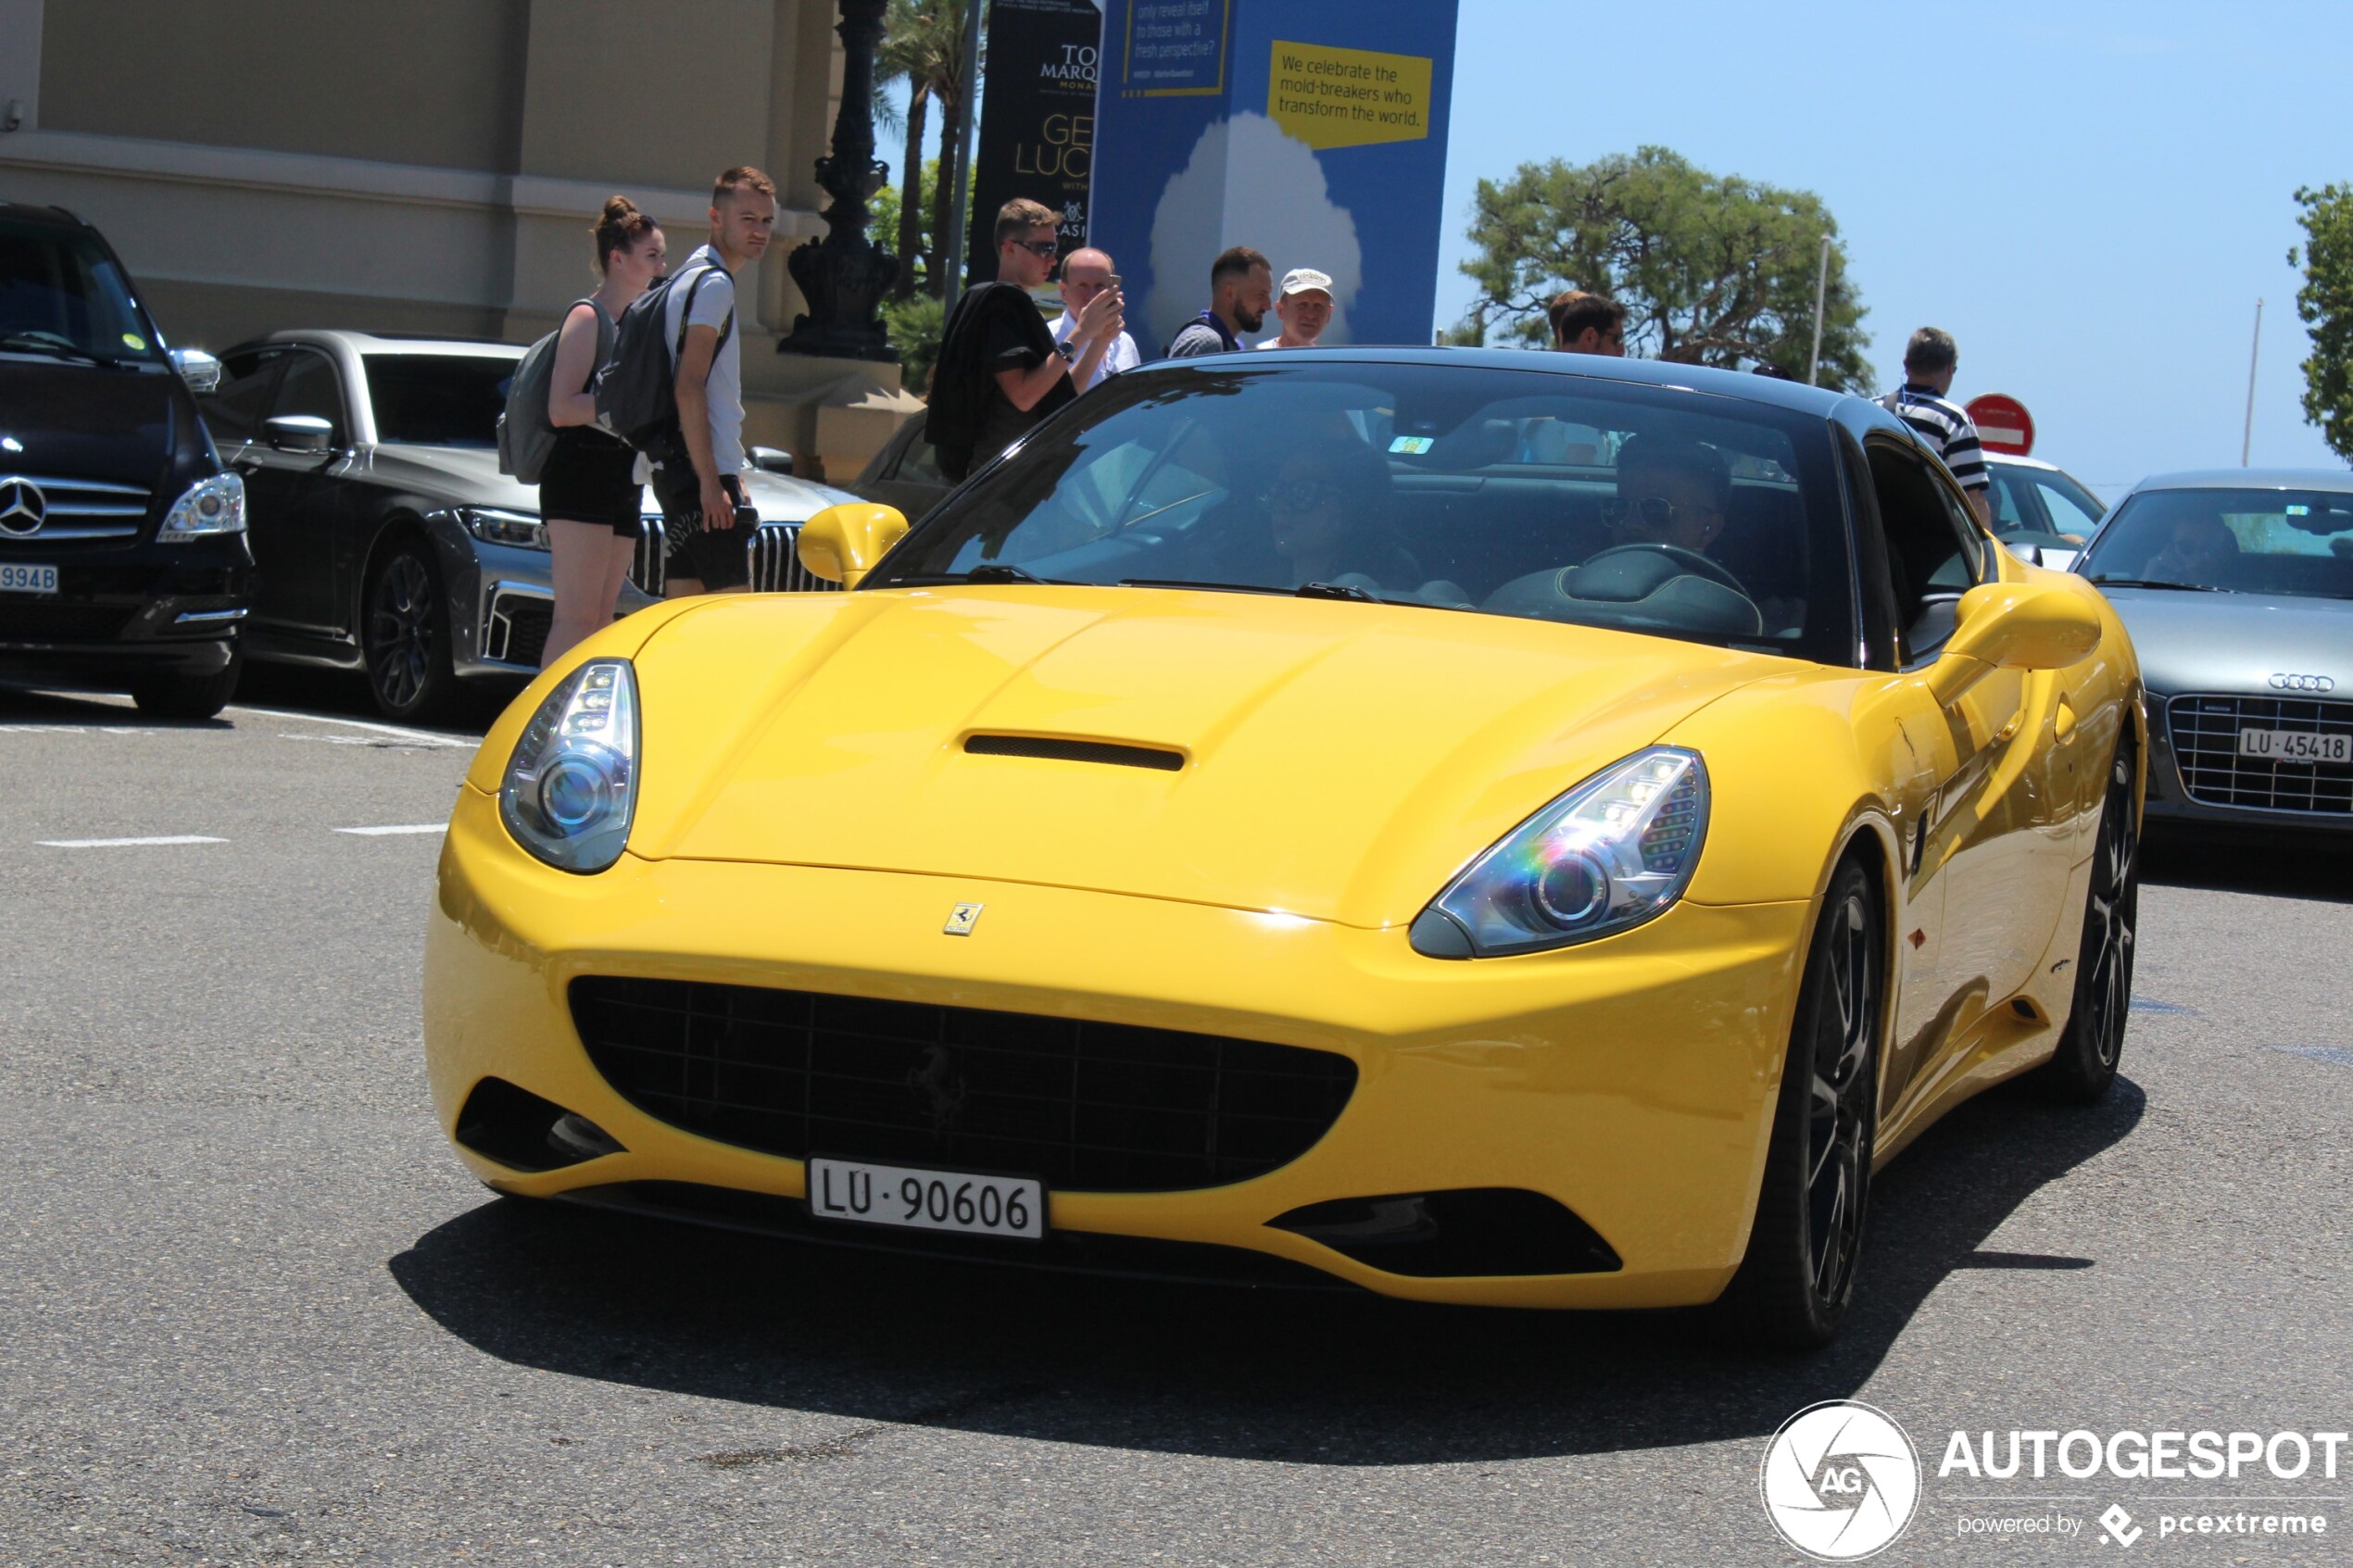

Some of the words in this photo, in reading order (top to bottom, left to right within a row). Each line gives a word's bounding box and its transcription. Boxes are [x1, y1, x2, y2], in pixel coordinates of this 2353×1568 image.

[1158, 2, 1186, 18] reveal
[1137, 25, 1147, 39] to
[1148, 23, 1172, 38] those
[1175, 20, 1192, 37] with
[1194, 23, 1202, 36] a
[1061, 44, 1097, 66] TO
[1135, 43, 1157, 58] fresh
[1159, 40, 1215, 60] perspective?
[1039, 63, 1098, 83] MARQ
[1282, 55, 1303, 72] We
[1307, 59, 1371, 80] celebrate
[1376, 66, 1398, 82] the
[1280, 78, 1379, 101] mold-breakers
[1384, 89, 1413, 105] who
[1279, 97, 1348, 119] transform
[1353, 106, 1374, 122] the
[1378, 110, 1420, 127] world.
[1044, 114, 1094, 146] GE
[1015, 143, 1089, 178] LUC
[1056, 223, 1086, 238] ASI
